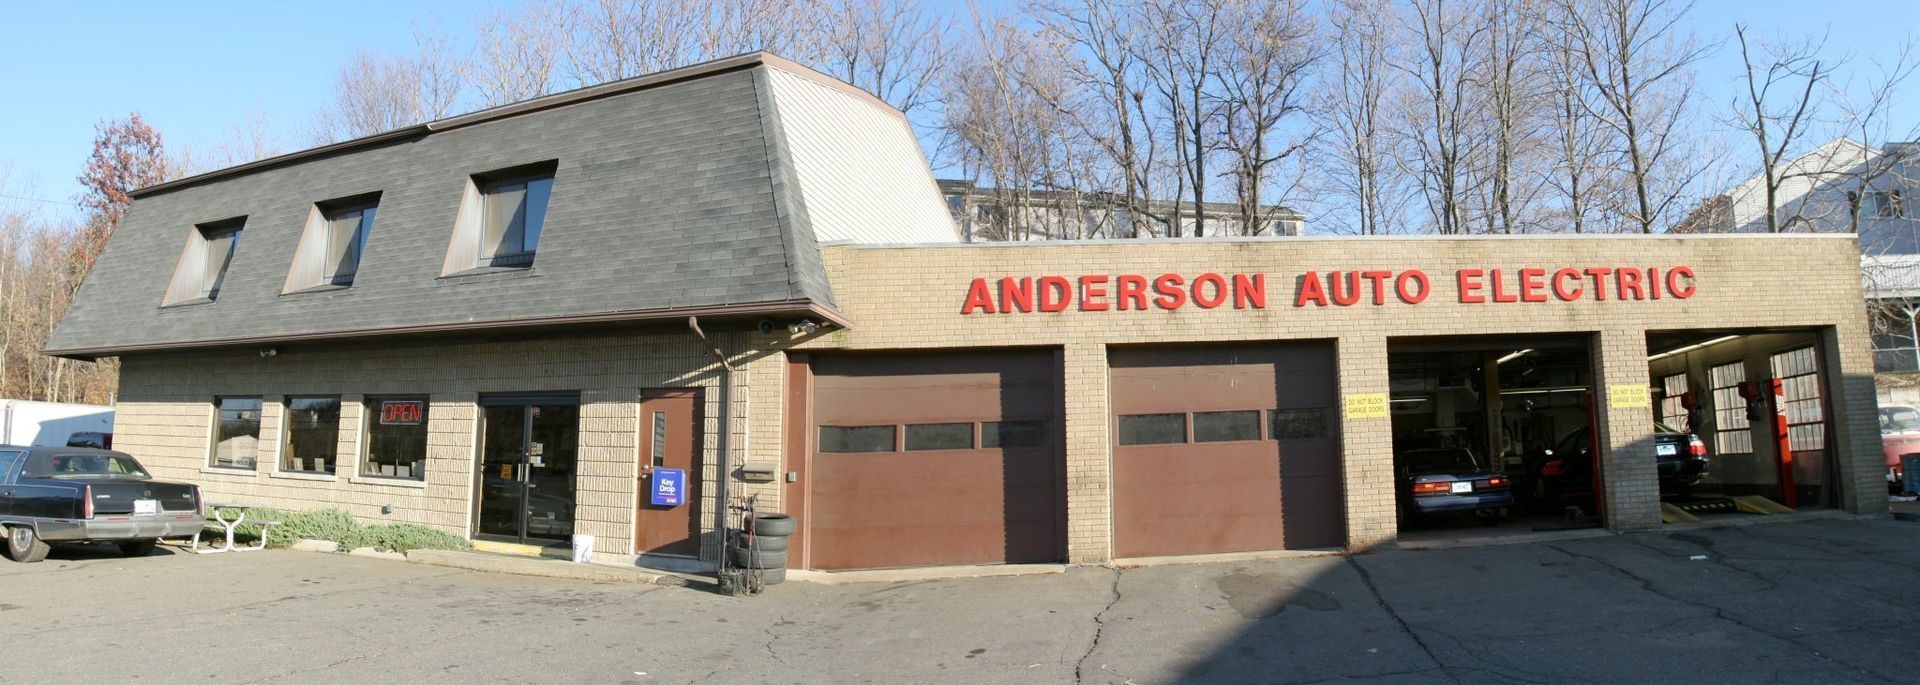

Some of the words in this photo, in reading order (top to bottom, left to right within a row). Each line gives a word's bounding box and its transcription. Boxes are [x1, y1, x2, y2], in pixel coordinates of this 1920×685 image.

[964, 273, 1265, 313] ANDERSON
[1298, 270, 1430, 306] AUTO
[1460, 266, 1696, 303] ELECTRIC
[383, 404, 420, 421] OPEN
[661, 478, 674, 487] Key
[659, 485, 676, 494] Drop
